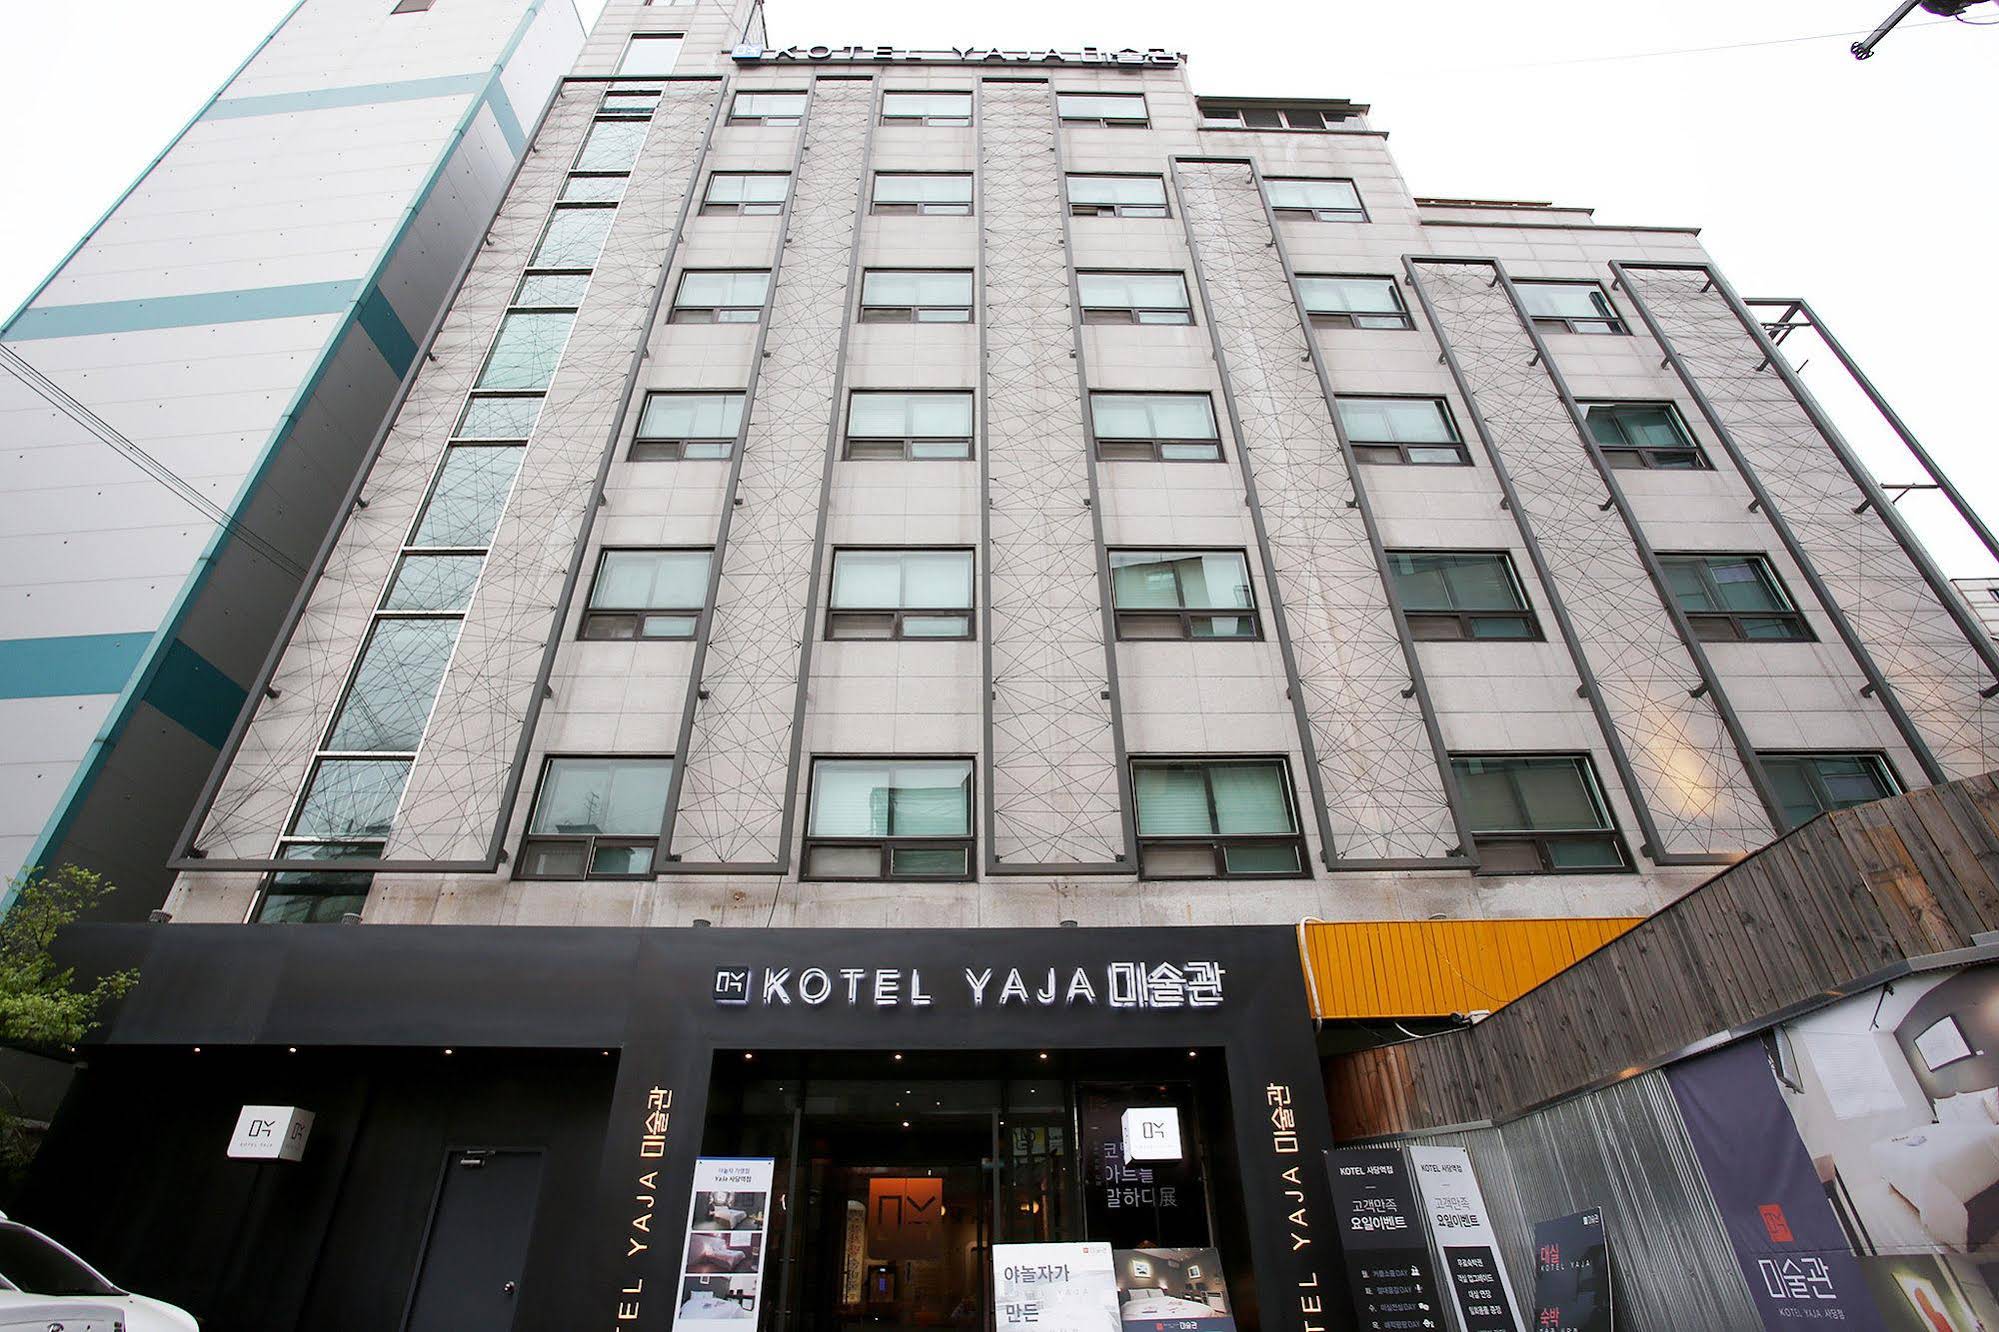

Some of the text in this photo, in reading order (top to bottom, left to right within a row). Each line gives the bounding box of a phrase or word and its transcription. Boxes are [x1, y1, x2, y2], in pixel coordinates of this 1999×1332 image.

[775, 46, 921, 60] KOTEL
[952, 46, 1064, 61] YAJA
[763, 961, 1226, 1007] KOTEL YAJA 미술관
[640, 1086, 672, 1157] 미술관
[1266, 1083, 1299, 1152] 미술관
[1339, 1167, 1366, 1175] KOTEL
[1421, 1164, 1441, 1173] KOTEL
[1282, 1166, 1311, 1250] YAJA
[1352, 1198, 1398, 1213] 고객만족
[1434, 1196, 1470, 1211] 고객만족
[627, 1171, 658, 1256] YAJA
[1436, 1214, 1481, 1228] 요일이벤트
[1351, 1216, 1408, 1231] 요일이벤트
[1540, 1244, 1560, 1264] 대실
[1004, 1264, 1070, 1283] 야놀자가
[1757, 1257, 1837, 1299] 미술관
[1006, 1303, 1039, 1323] 만든
[1540, 1307, 1560, 1327] 숙박
[1779, 1308, 1803, 1318] KOTEL
[1804, 1308, 1823, 1318] YAJA
